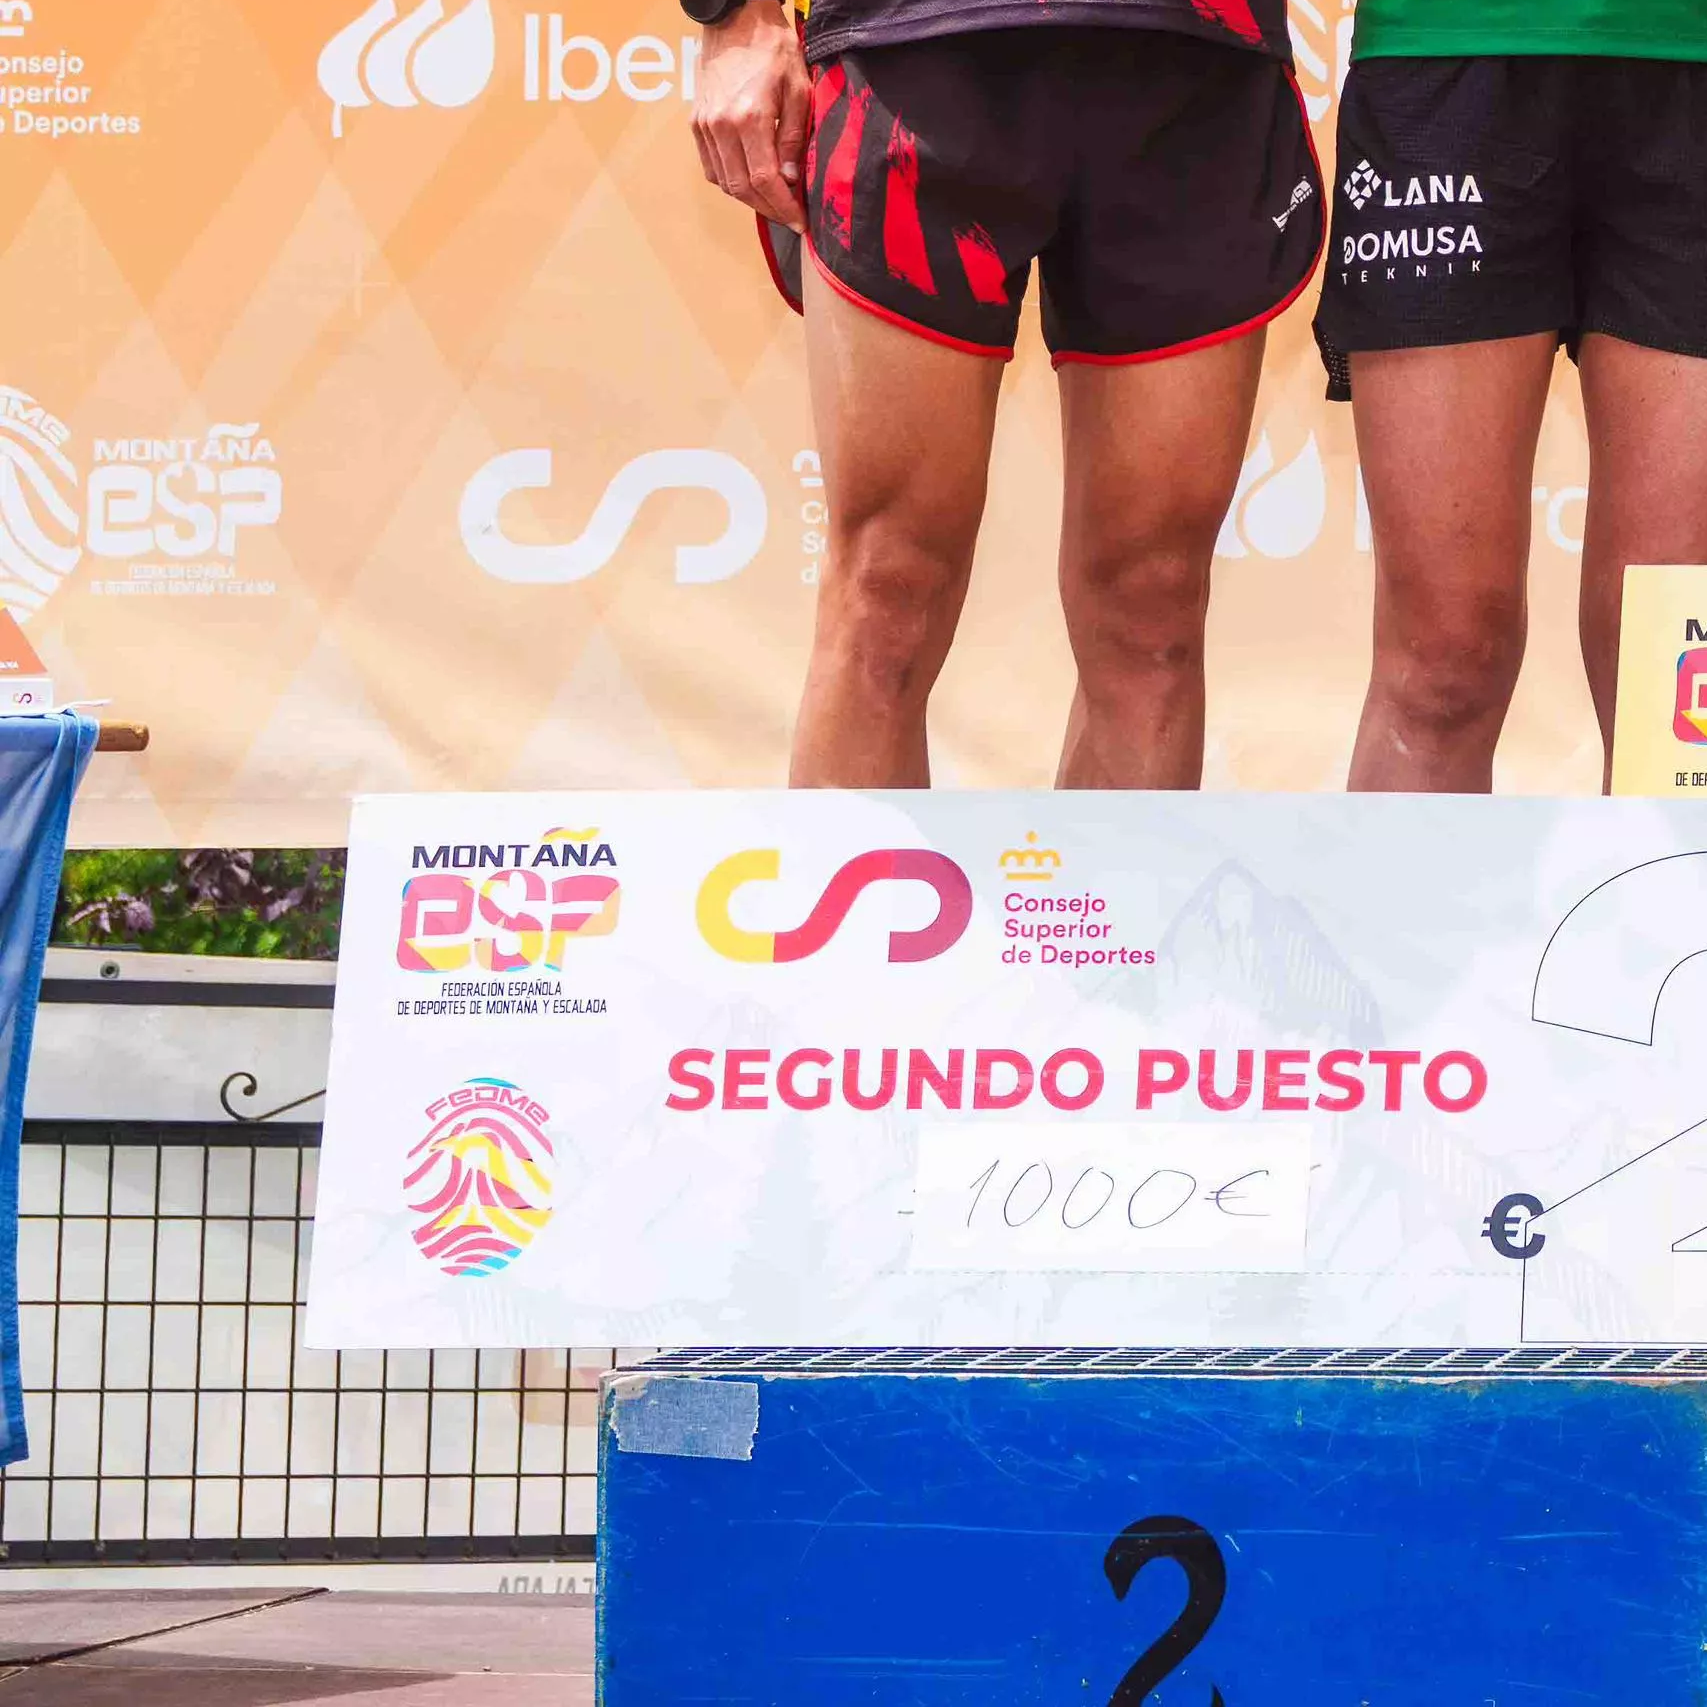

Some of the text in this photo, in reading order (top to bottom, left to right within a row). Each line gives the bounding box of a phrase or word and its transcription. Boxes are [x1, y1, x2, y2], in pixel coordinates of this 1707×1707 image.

[0, 49, 85, 80] onsejo
[0, 81, 92, 109] perior
[13, 110, 141, 139] Deportes
[1383, 173, 1484, 209] LANA
[1342, 223, 1484, 266] DOMUSA
[1341, 258, 1482, 287] TEKNIK
[93, 423, 276, 461] MONTAÑA
[1676, 771, 1688, 787] DE
[411, 826, 618, 869] MONTAÑA
[1003, 892, 1107, 919] Consejo
[1003, 917, 1113, 945] Superior
[1001, 944, 1157, 970] de Deportes
[441, 976, 562, 998] FEDERACIÓN ESPAÑOLA
[397, 994, 608, 1016] DE DEPORTES DE MONTAÑA Y ESCALADA
[665, 1046, 1489, 1114] SEGUNDO PUESTO
[967, 1159, 1271, 1230] 1000€
[1480, 1191, 1547, 1260] €
[1102, 1513, 1227, 1707] 2
